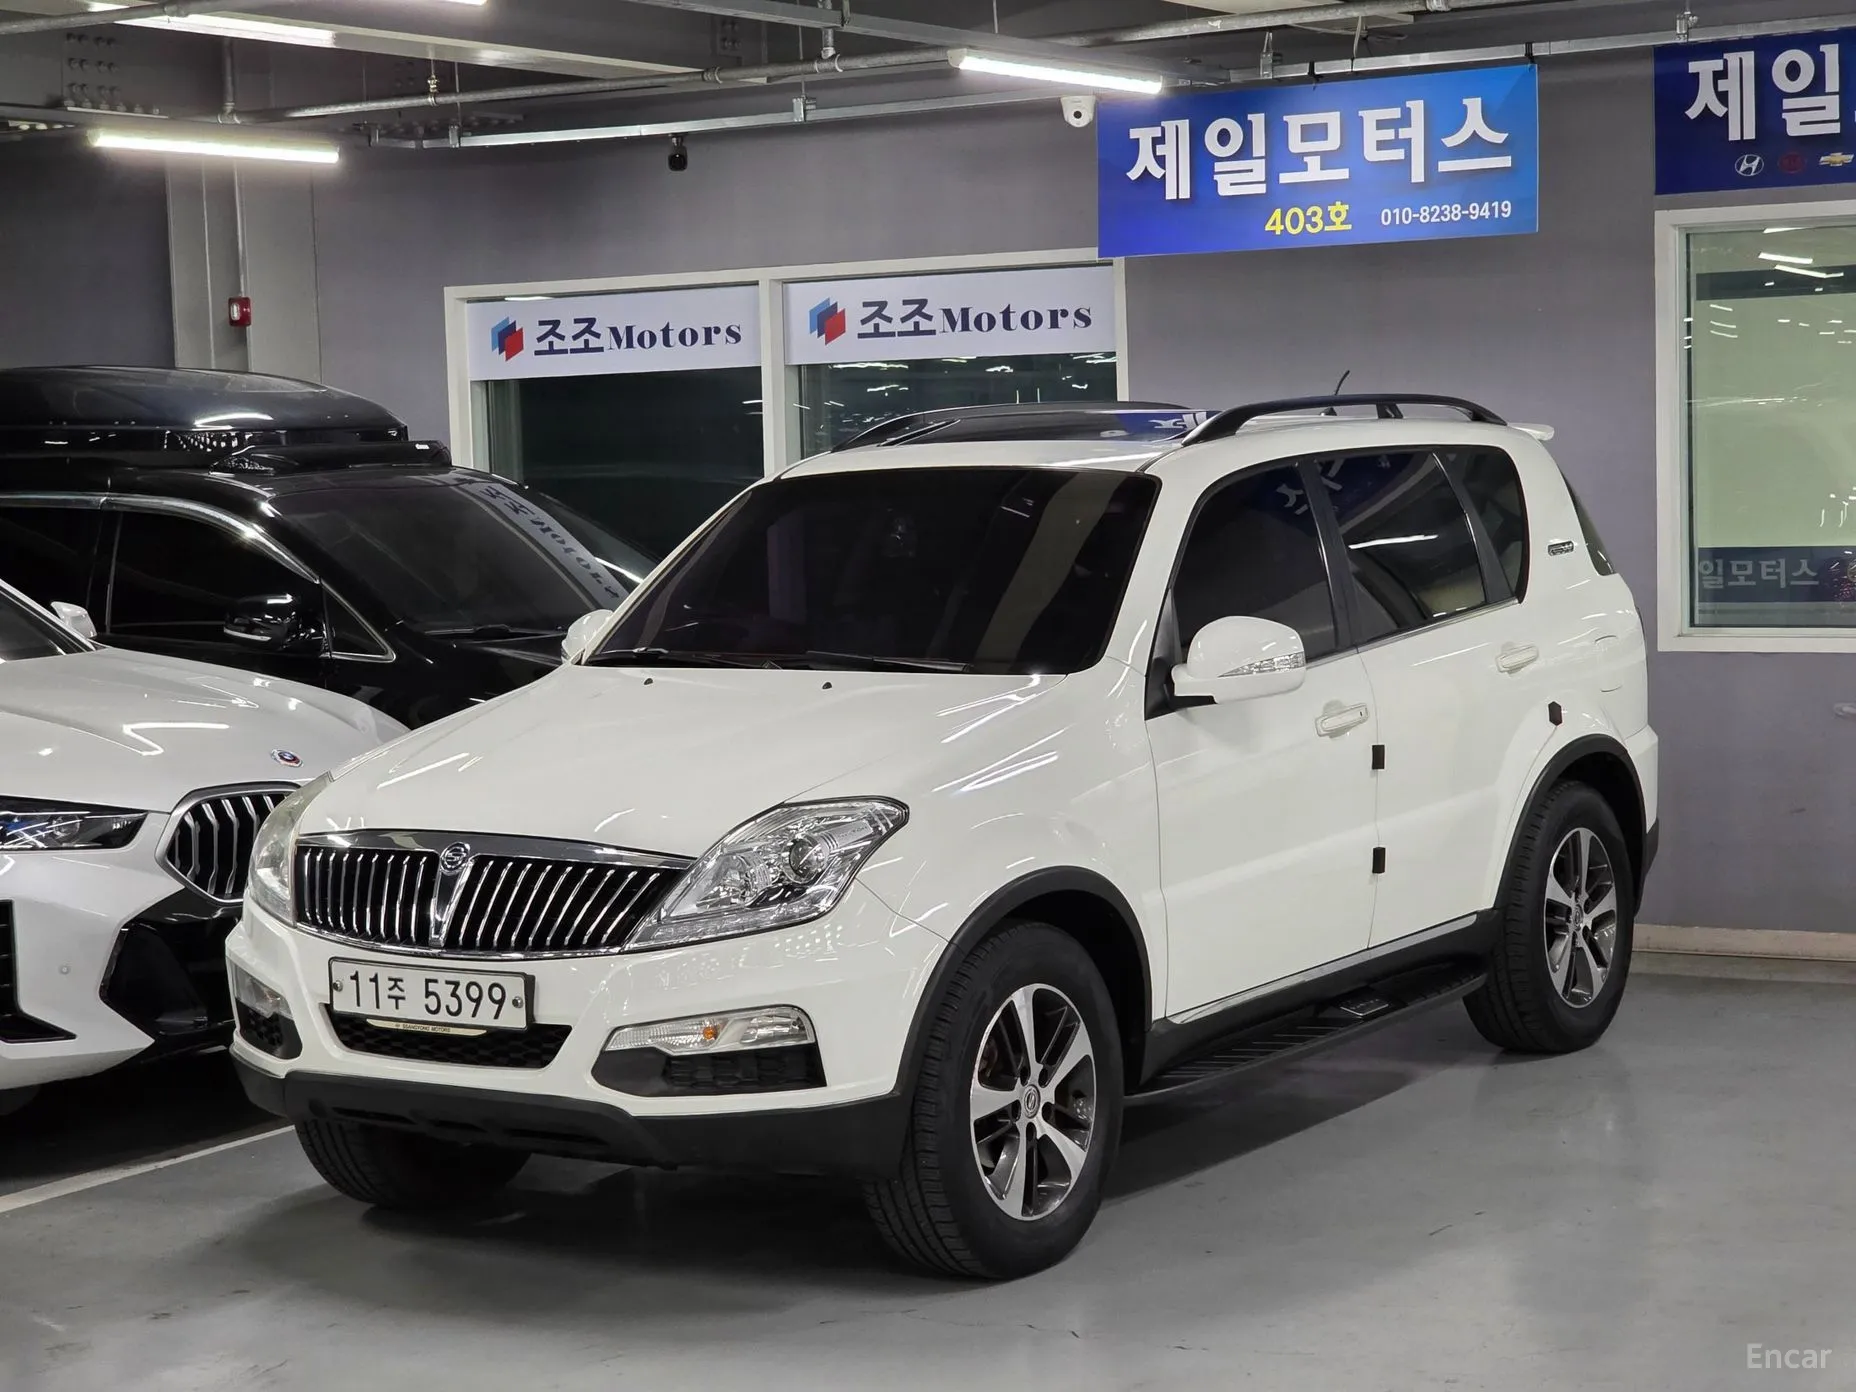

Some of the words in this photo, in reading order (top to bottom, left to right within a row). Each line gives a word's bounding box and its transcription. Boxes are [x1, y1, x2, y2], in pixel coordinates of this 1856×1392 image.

[1685, 43, 1856, 141] 제일
[1126, 97, 1512, 200] 제일모터스
[1264, 201, 1352, 235] 403호
[1380, 200, 1512, 226] 010-8238-9419
[350, 970, 406, 1010] 11주
[424, 977, 507, 1020] 5399
